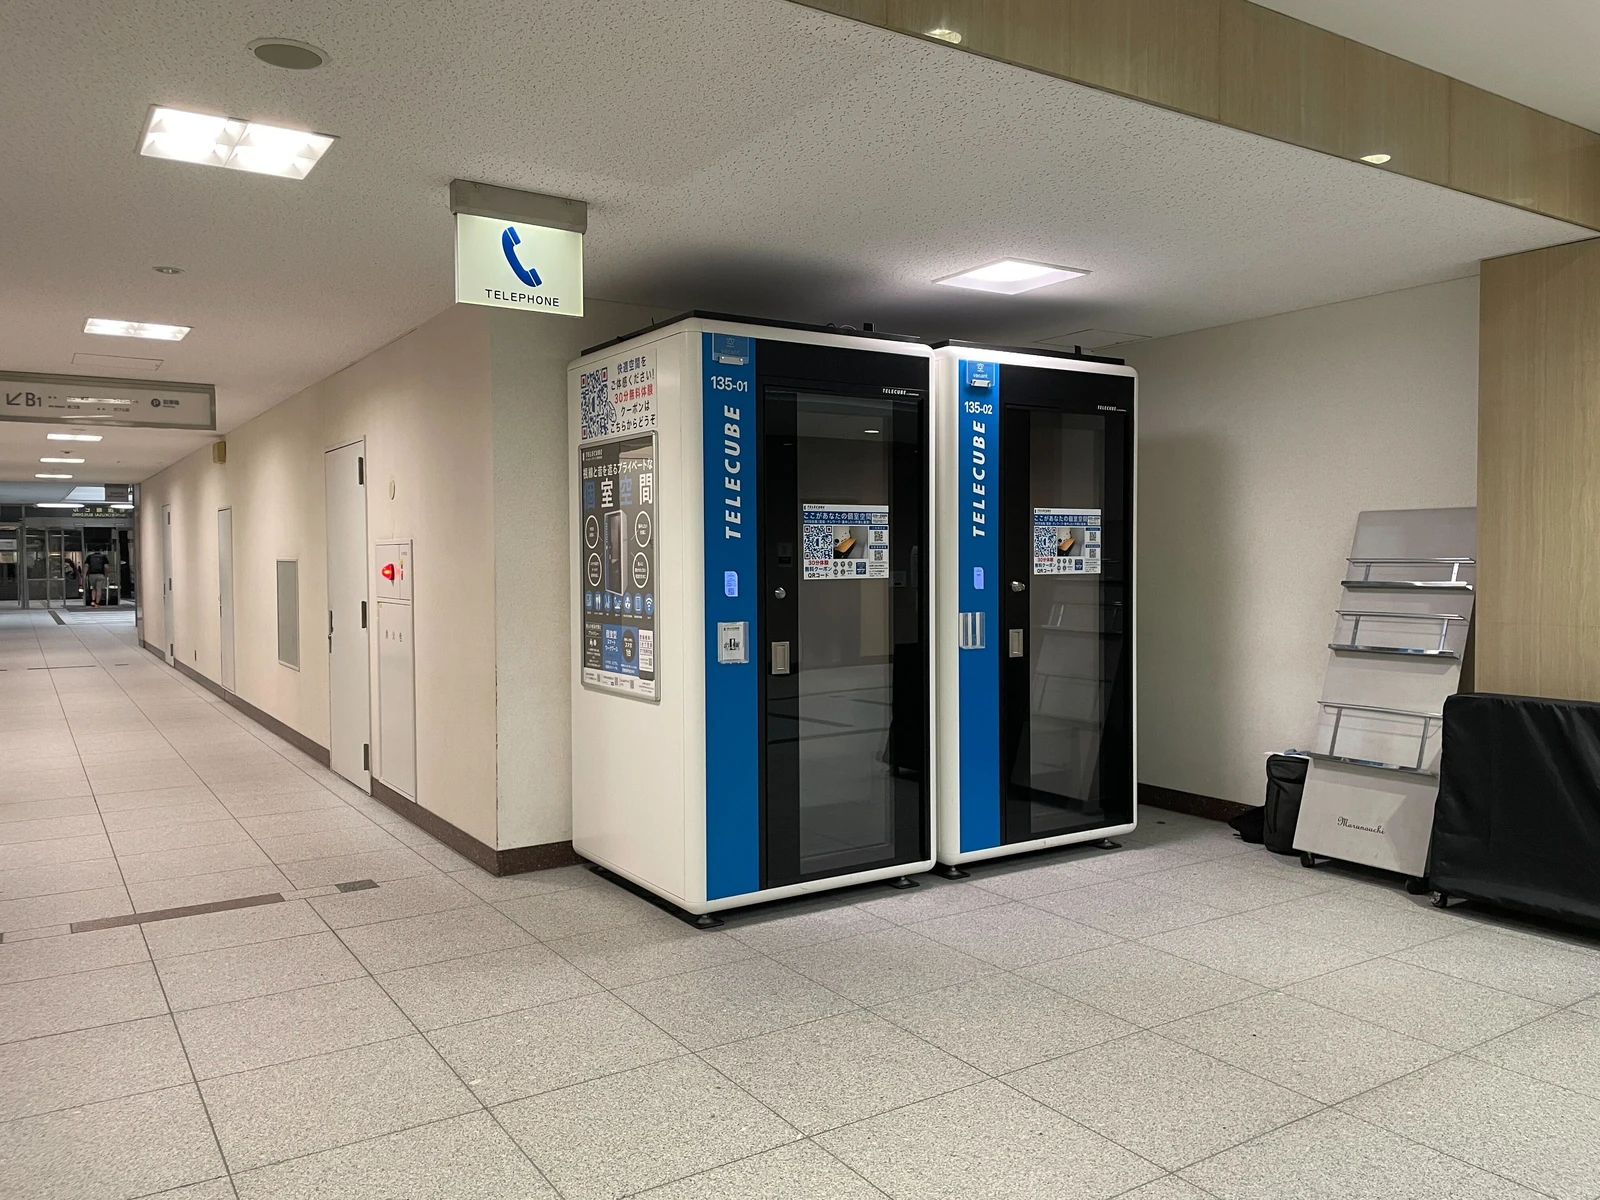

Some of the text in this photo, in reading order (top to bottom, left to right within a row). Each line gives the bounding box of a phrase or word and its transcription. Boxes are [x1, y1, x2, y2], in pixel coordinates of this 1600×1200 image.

[484, 288, 560, 307] TELEPHONE
[617, 356, 646, 375] 快適空間を
[614, 383, 653, 404] 30分無料体験
[710, 376, 748, 393] 135-01
[882, 388, 907, 396] TELECUBE
[25, 392, 42, 407] B1
[620, 400, 650, 417] クーポンは
[964, 401, 993, 415] 135-02
[610, 413, 656, 434] こちらからどうぞ
[724, 404, 742, 539] TELECUBE
[972, 420, 986, 537] TELECUBE
[803, 512, 872, 520] ここがあなたの個室空間
[1337, 816, 1386, 835] Marunouchi
